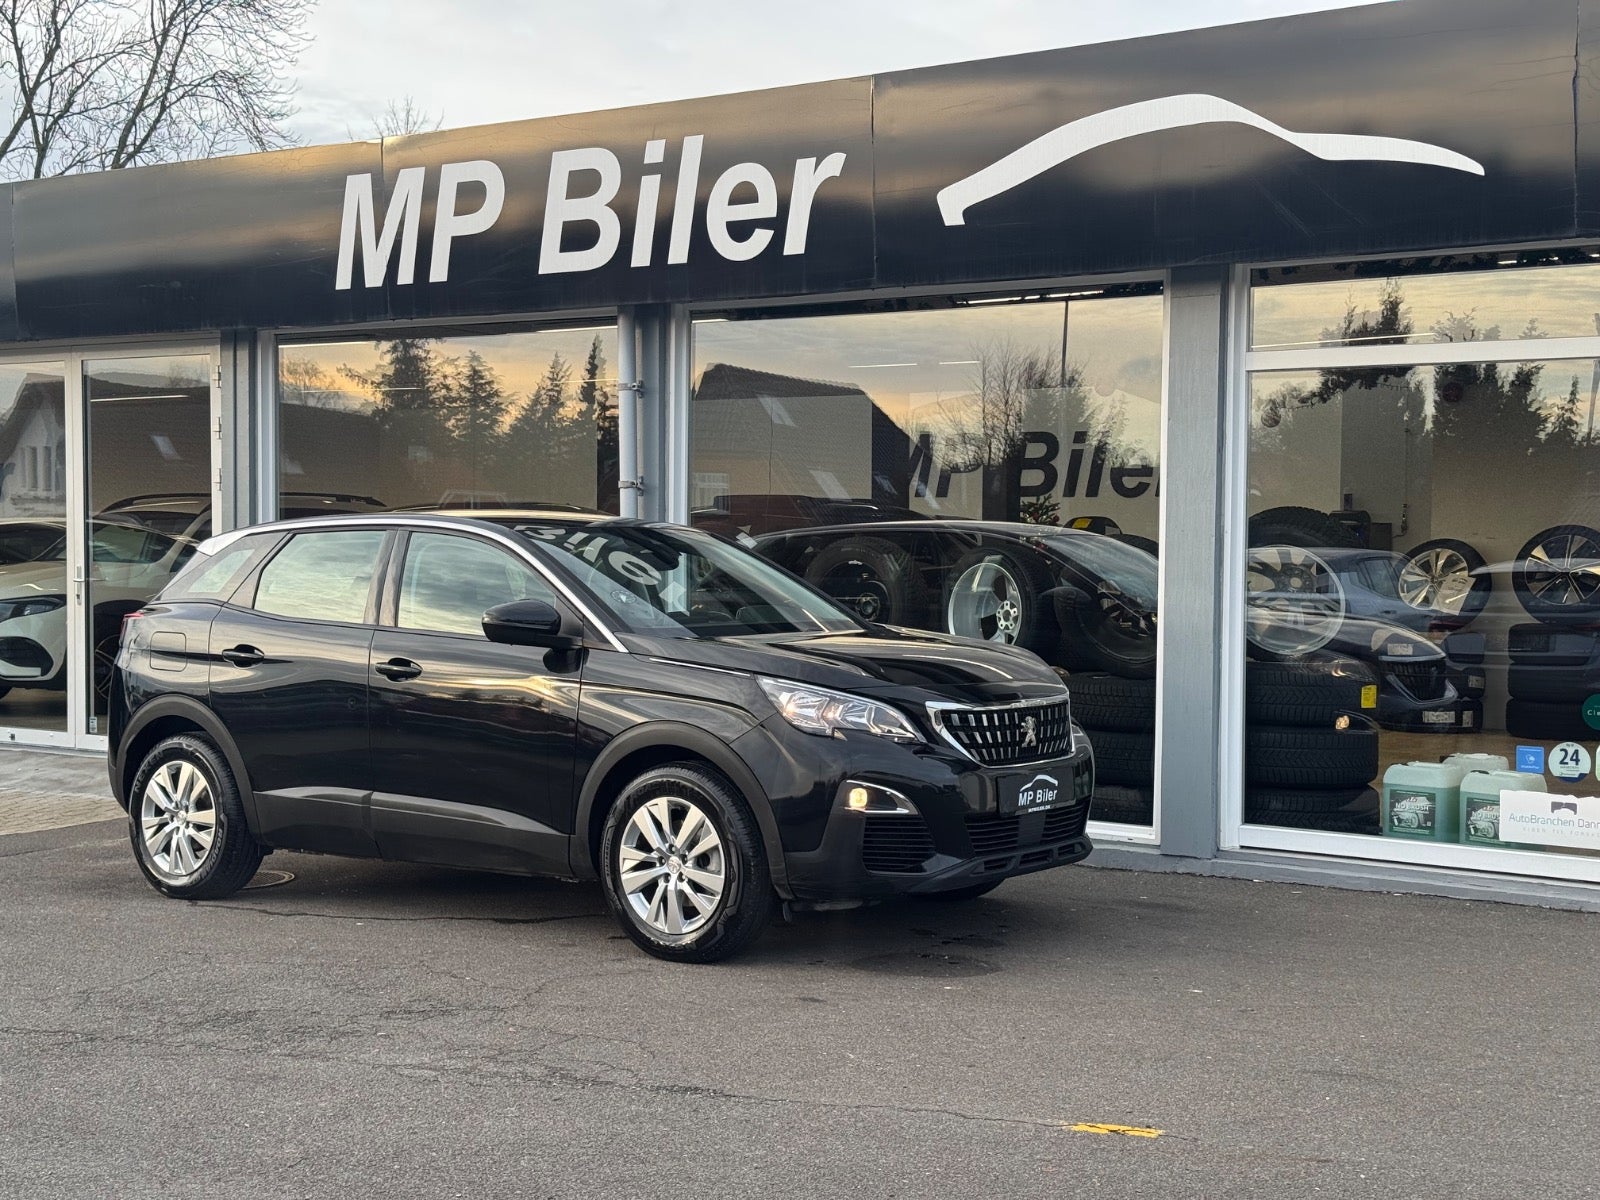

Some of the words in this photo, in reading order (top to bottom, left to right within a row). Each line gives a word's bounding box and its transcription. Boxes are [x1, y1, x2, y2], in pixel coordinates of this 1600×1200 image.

[335, 160, 505, 290] MP
[538, 134, 847, 275] Biler
[1019, 431, 1160, 499] Bile
[1559, 748, 1581, 766] 24
[1018, 791, 1034, 806] MP
[1036, 788, 1057, 803] Biler
[1508, 813, 1575, 827] AutoBranchen
